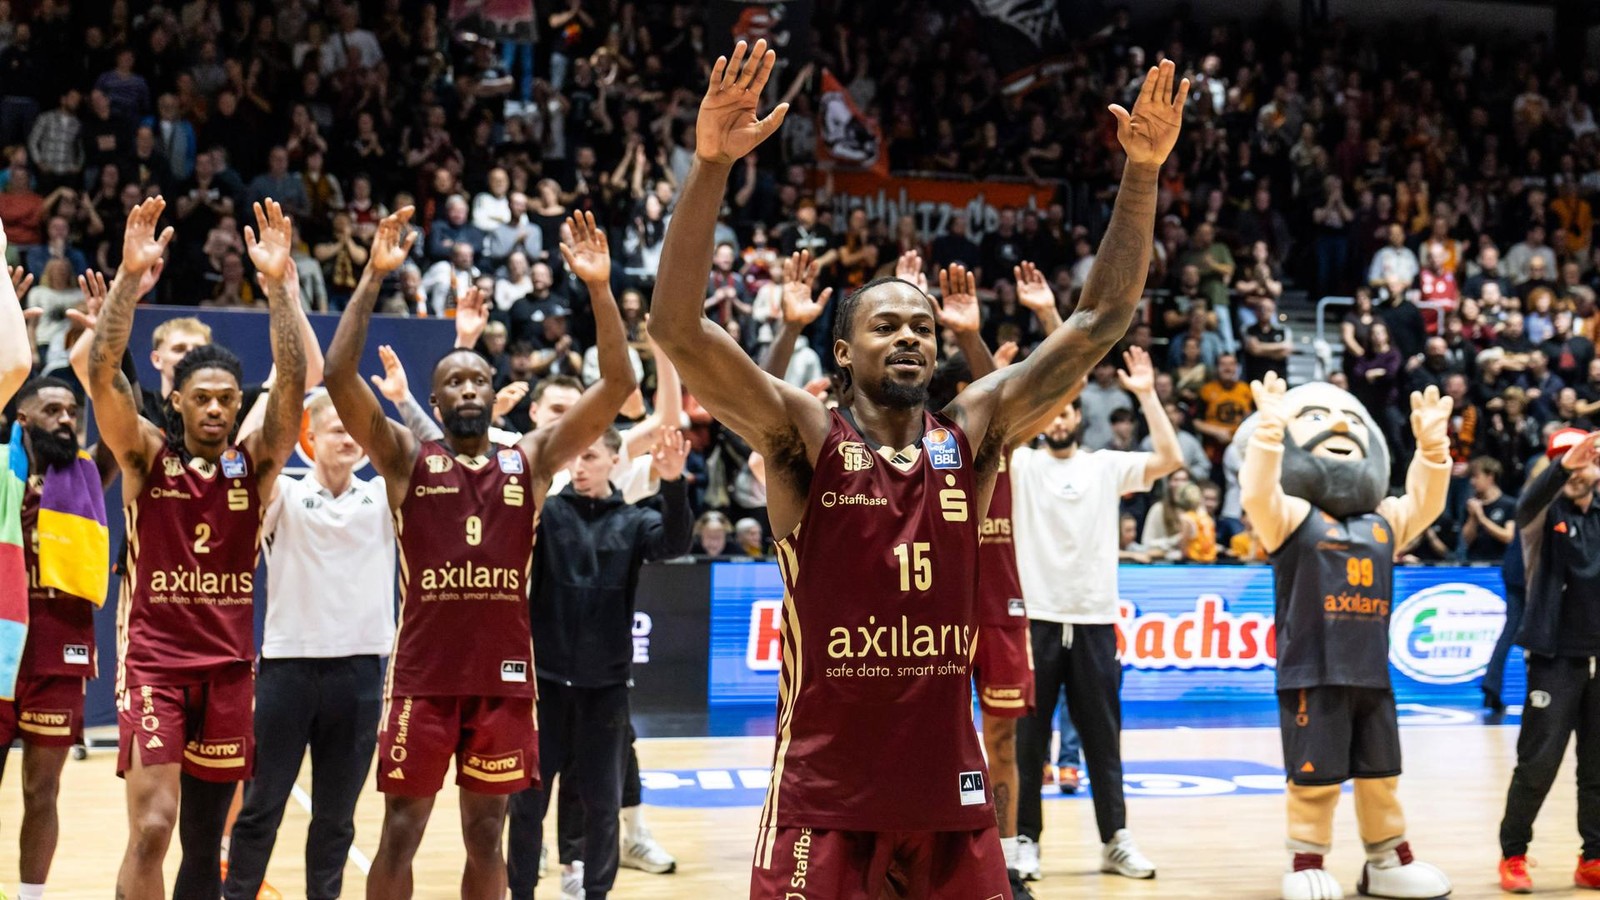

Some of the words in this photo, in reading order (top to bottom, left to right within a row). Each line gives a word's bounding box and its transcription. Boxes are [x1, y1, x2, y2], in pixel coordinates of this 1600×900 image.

[934, 454, 957, 465] BBL
[838, 493, 888, 506] Staffbase
[193, 523, 210, 554] 2
[465, 515, 482, 546] 9
[150, 564, 254, 594] axilaris
[421, 560, 520, 590] axilaris
[893, 542, 933, 591] 15
[1346, 557, 1374, 587] 99
[827, 614, 970, 659] axilaris
[826, 662, 854, 678] safe
[856, 662, 894, 678] data.
[897, 664, 934, 677] smart
[33, 712, 65, 725] LOTTO
[395, 696, 413, 745] Staffbas
[199, 743, 238, 756] LOTTO
[481, 756, 517, 771] LOTTO
